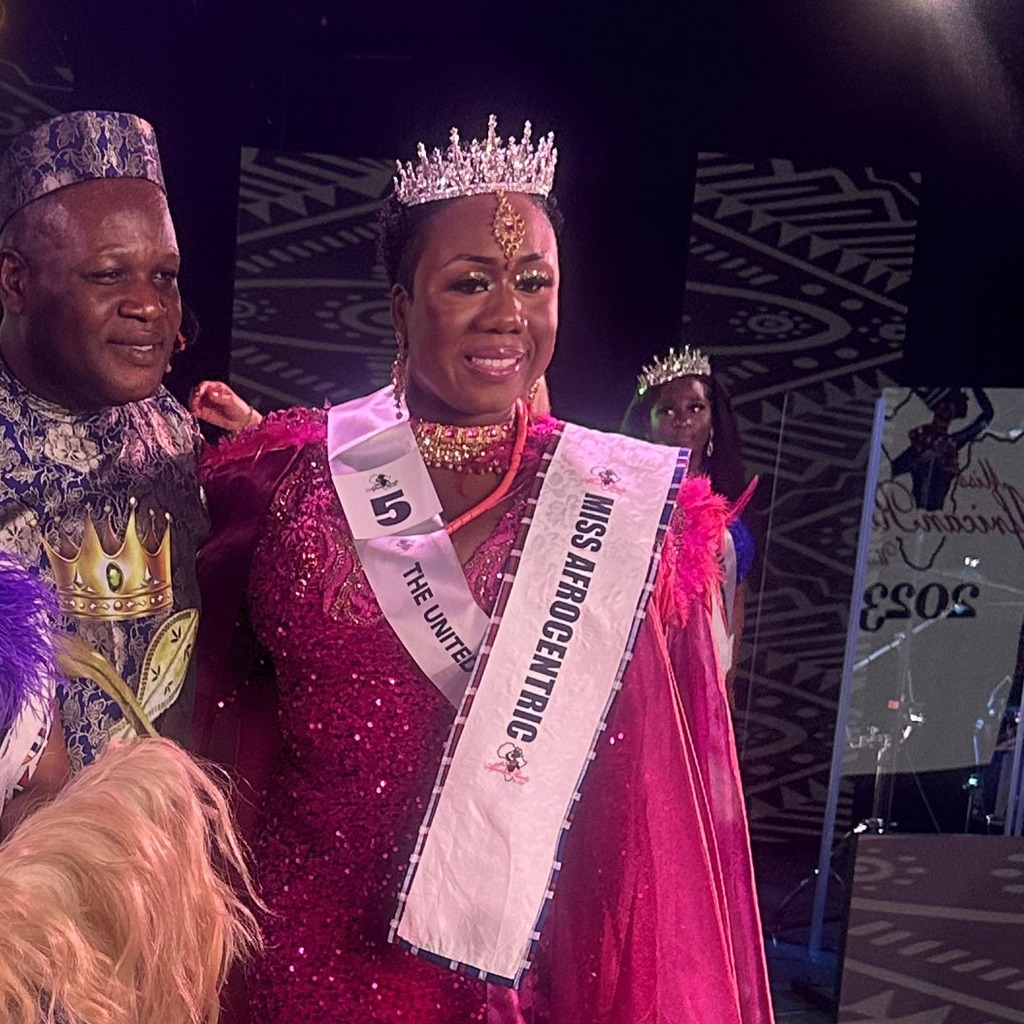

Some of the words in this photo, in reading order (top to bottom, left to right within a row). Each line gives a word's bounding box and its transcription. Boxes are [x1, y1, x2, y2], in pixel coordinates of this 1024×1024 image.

[370, 489, 412, 526] 5
[571, 492, 614, 553] MISS
[402, 561, 433, 607] THE
[423, 604, 476, 673] UNITED
[507, 551, 596, 743] AFROCENTRIC
